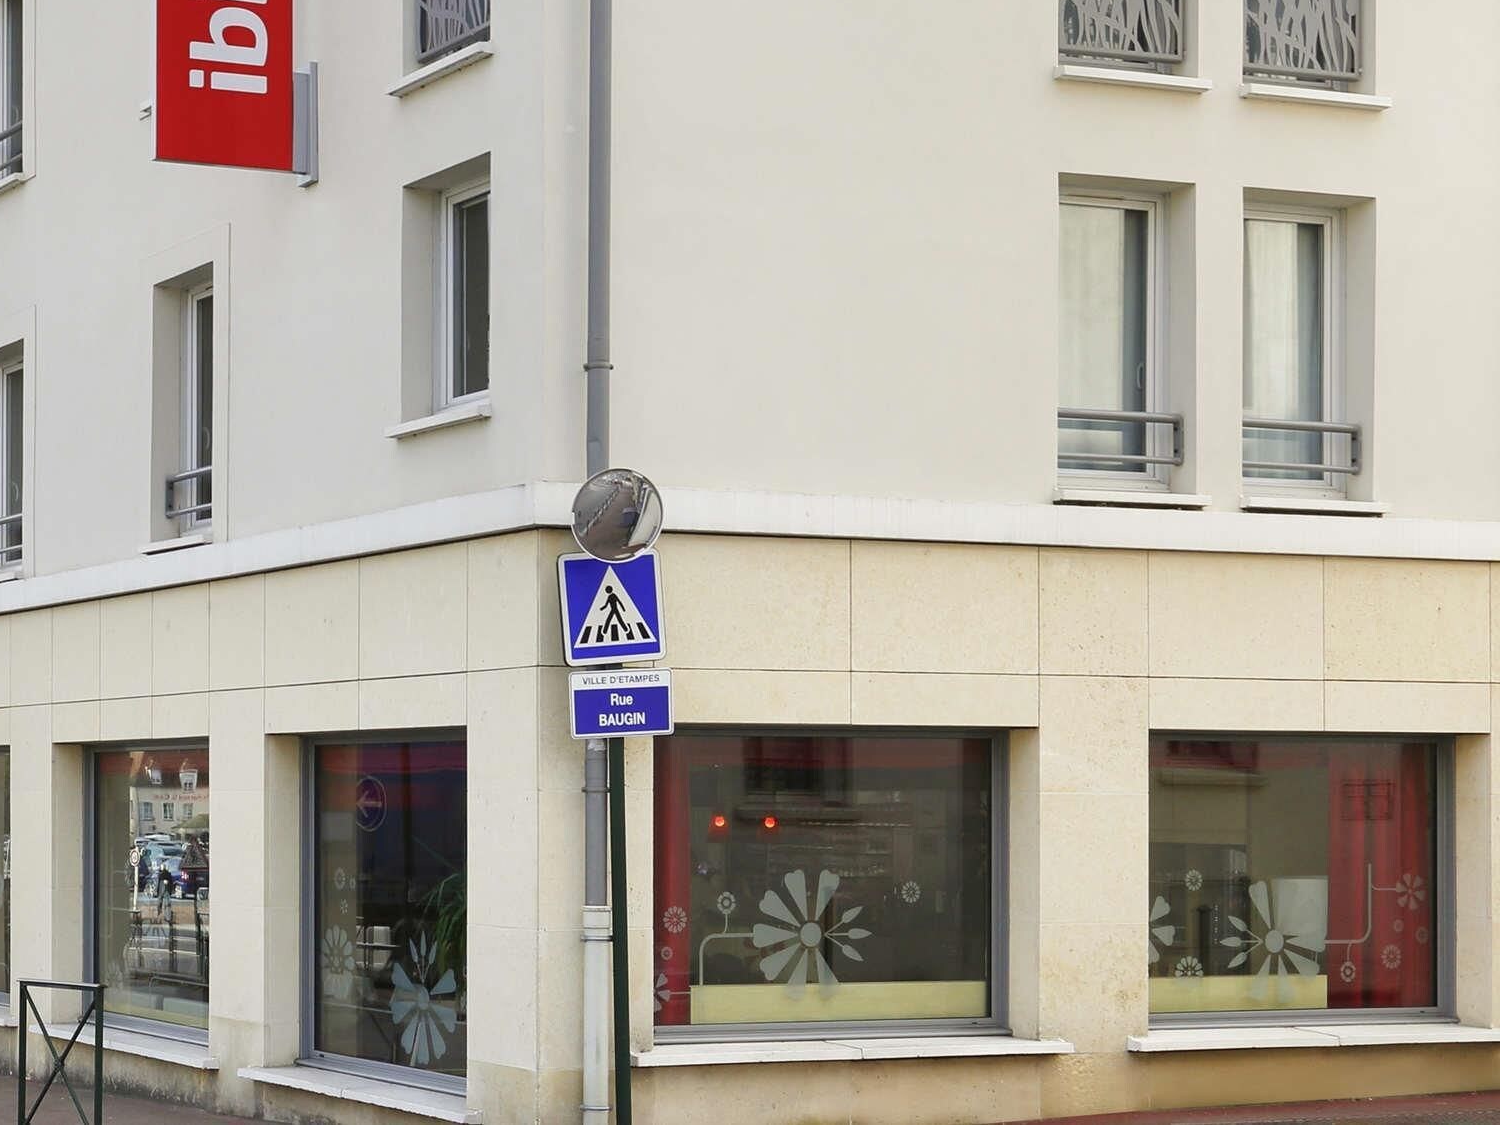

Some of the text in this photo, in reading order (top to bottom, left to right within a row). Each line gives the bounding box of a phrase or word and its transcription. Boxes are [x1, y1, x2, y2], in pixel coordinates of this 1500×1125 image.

[582, 674, 660, 685] VILLE D'ETAMPES
[610, 693, 633, 706] Rue
[599, 712, 646, 727] BAUGIN
